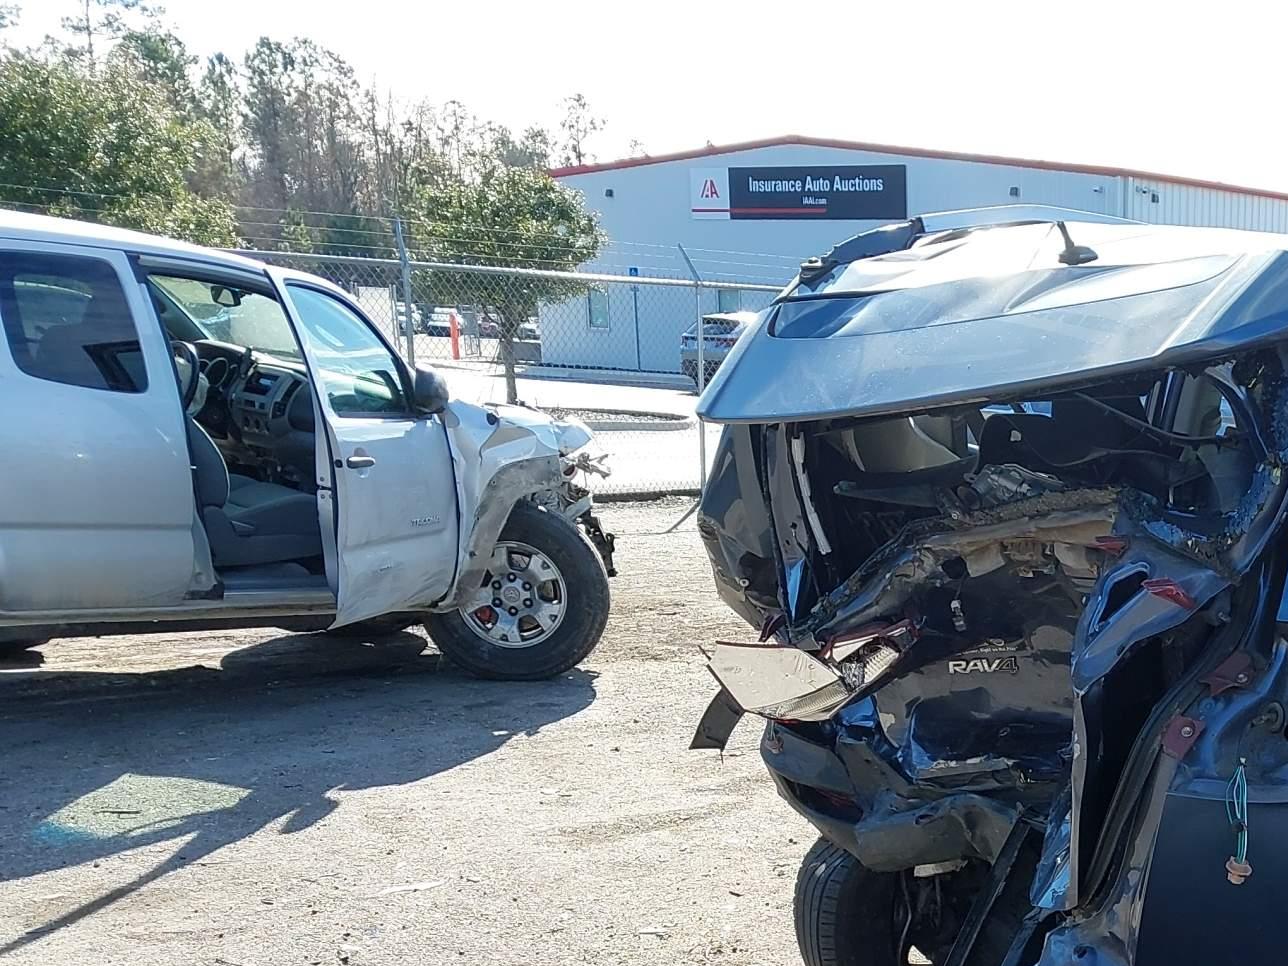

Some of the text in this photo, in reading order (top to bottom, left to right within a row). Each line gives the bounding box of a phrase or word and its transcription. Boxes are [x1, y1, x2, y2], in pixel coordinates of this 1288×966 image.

[748, 174, 884, 193] Insurance Auto Auctions
[948, 656, 1019, 674] RAV4
